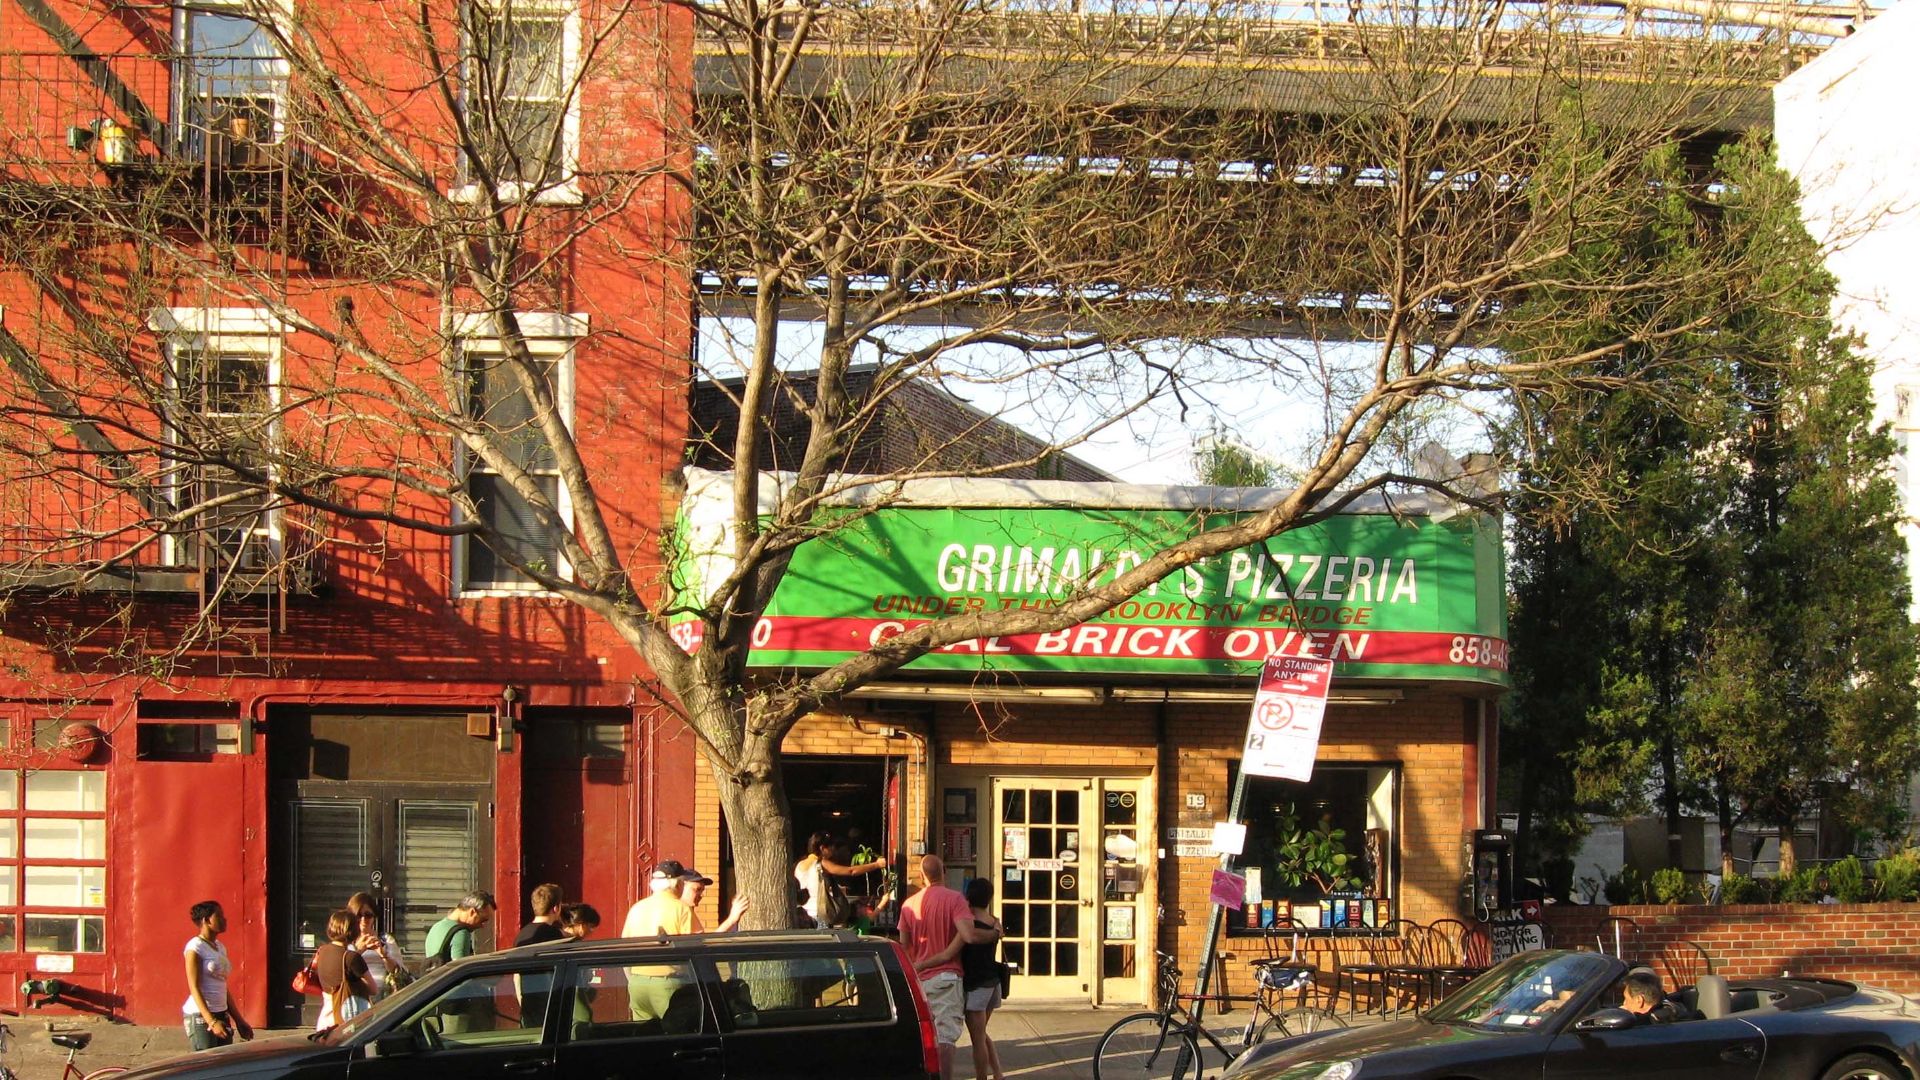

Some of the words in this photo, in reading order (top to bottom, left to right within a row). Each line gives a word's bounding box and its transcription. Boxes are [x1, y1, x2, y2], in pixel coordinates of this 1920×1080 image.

[1224, 552, 1417, 604] PIZZERIA
[872, 594, 986, 616] UNDER
[1257, 604, 1373, 625] BRIDGE
[1034, 625, 1201, 656] BRICK
[1223, 629, 1370, 660] OVEN
[1268, 659, 1281, 668] NO
[1285, 660, 1328, 673] STANDING
[1273, 670, 1319, 683] ANYTIME
[1189, 795, 1204, 806] 19
[1019, 860, 1030, 869] NO
[1034, 860, 1061, 870] SLICES
